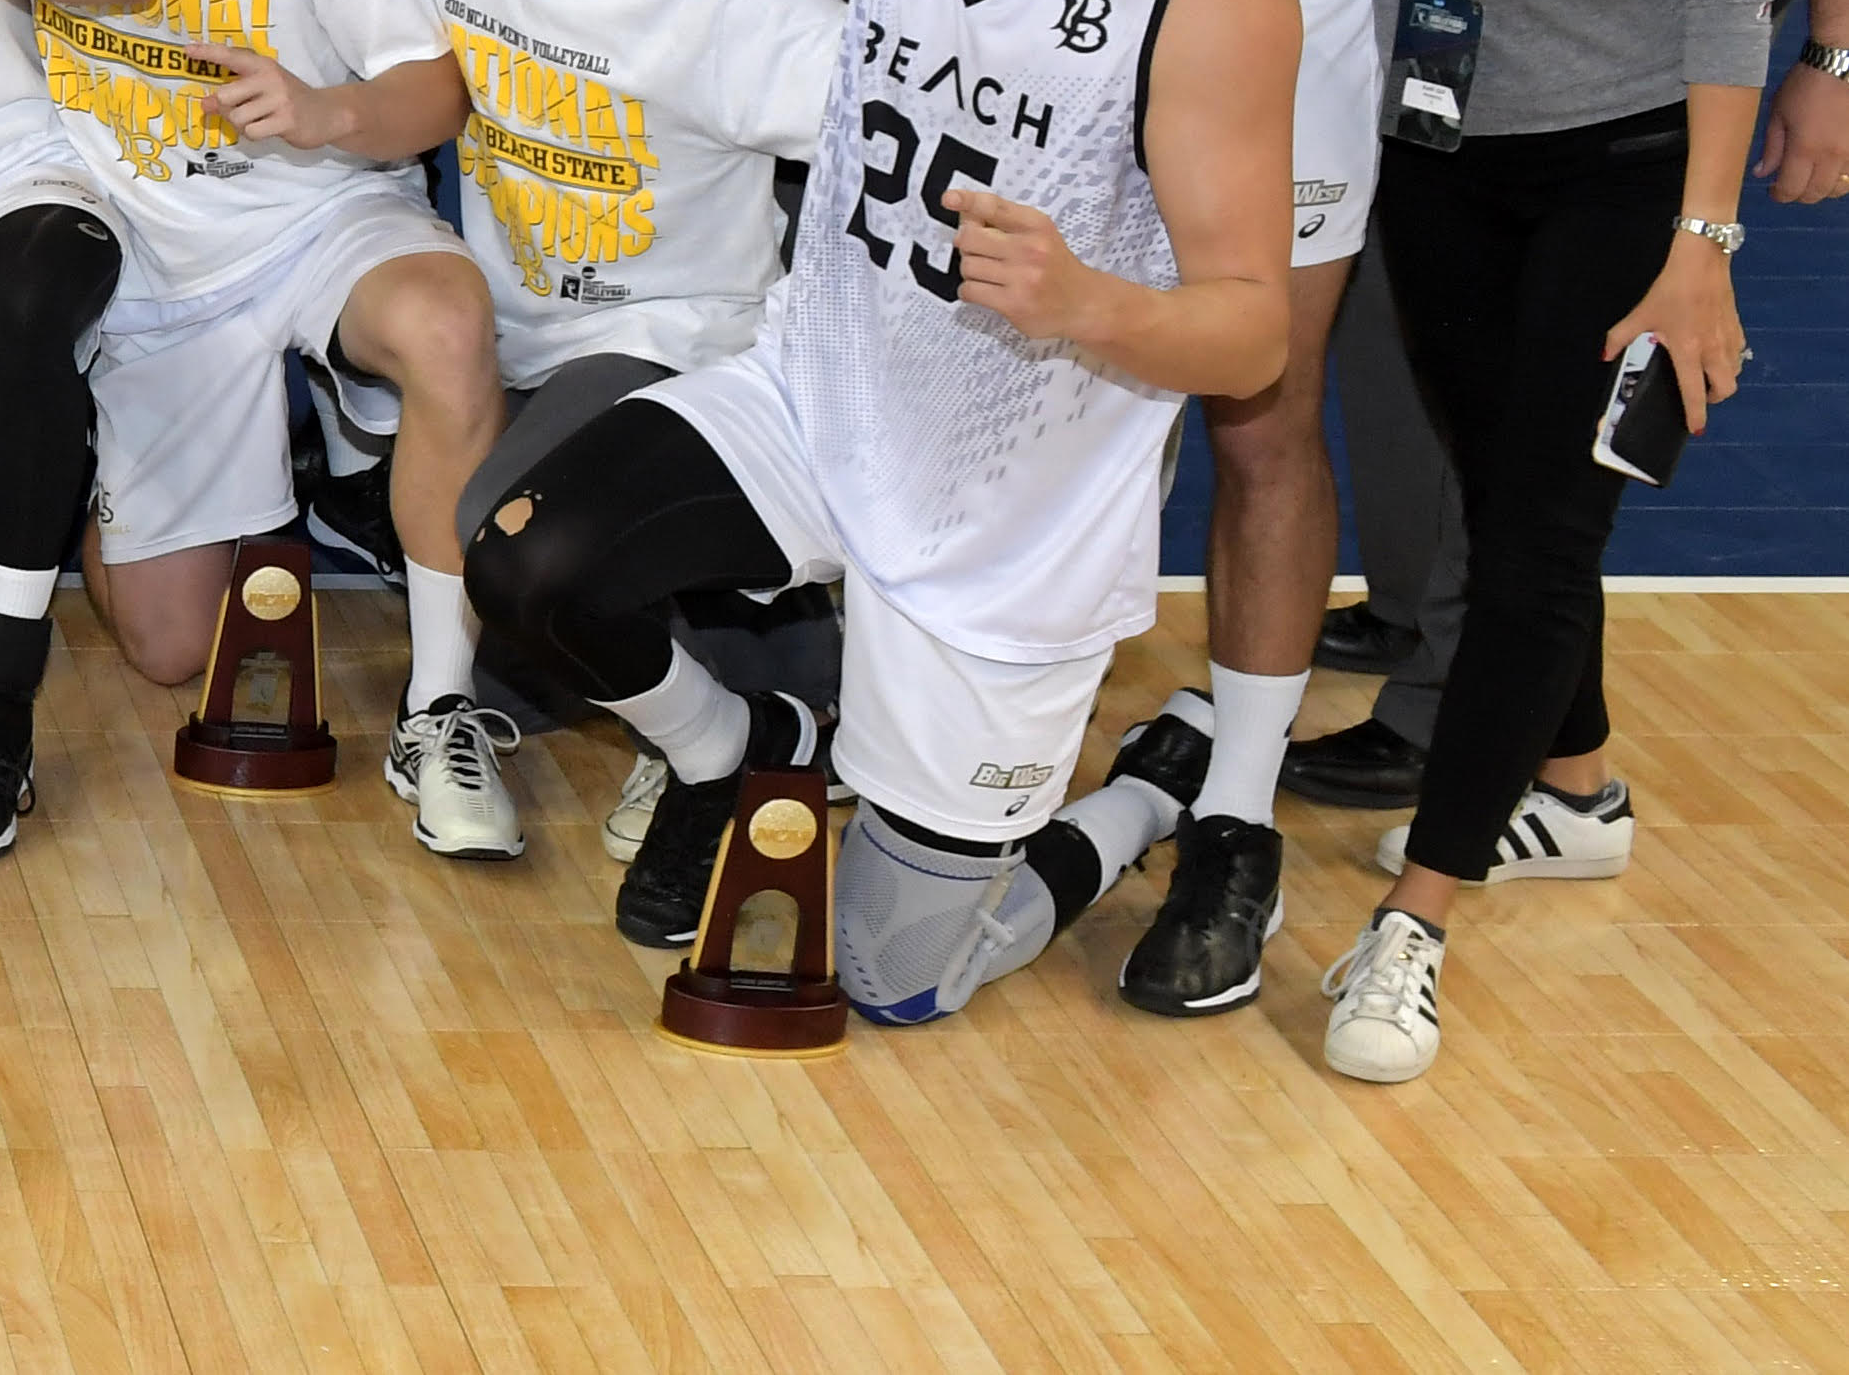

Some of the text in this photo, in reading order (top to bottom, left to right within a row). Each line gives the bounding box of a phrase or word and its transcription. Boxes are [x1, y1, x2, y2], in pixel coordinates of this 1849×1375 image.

[40, 1, 165, 69] LONG BEACH
[531, 35, 611, 76] VOLLEYBALL
[484, 122, 627, 187] BEACH STATE
[845, 99, 999, 303] 25
